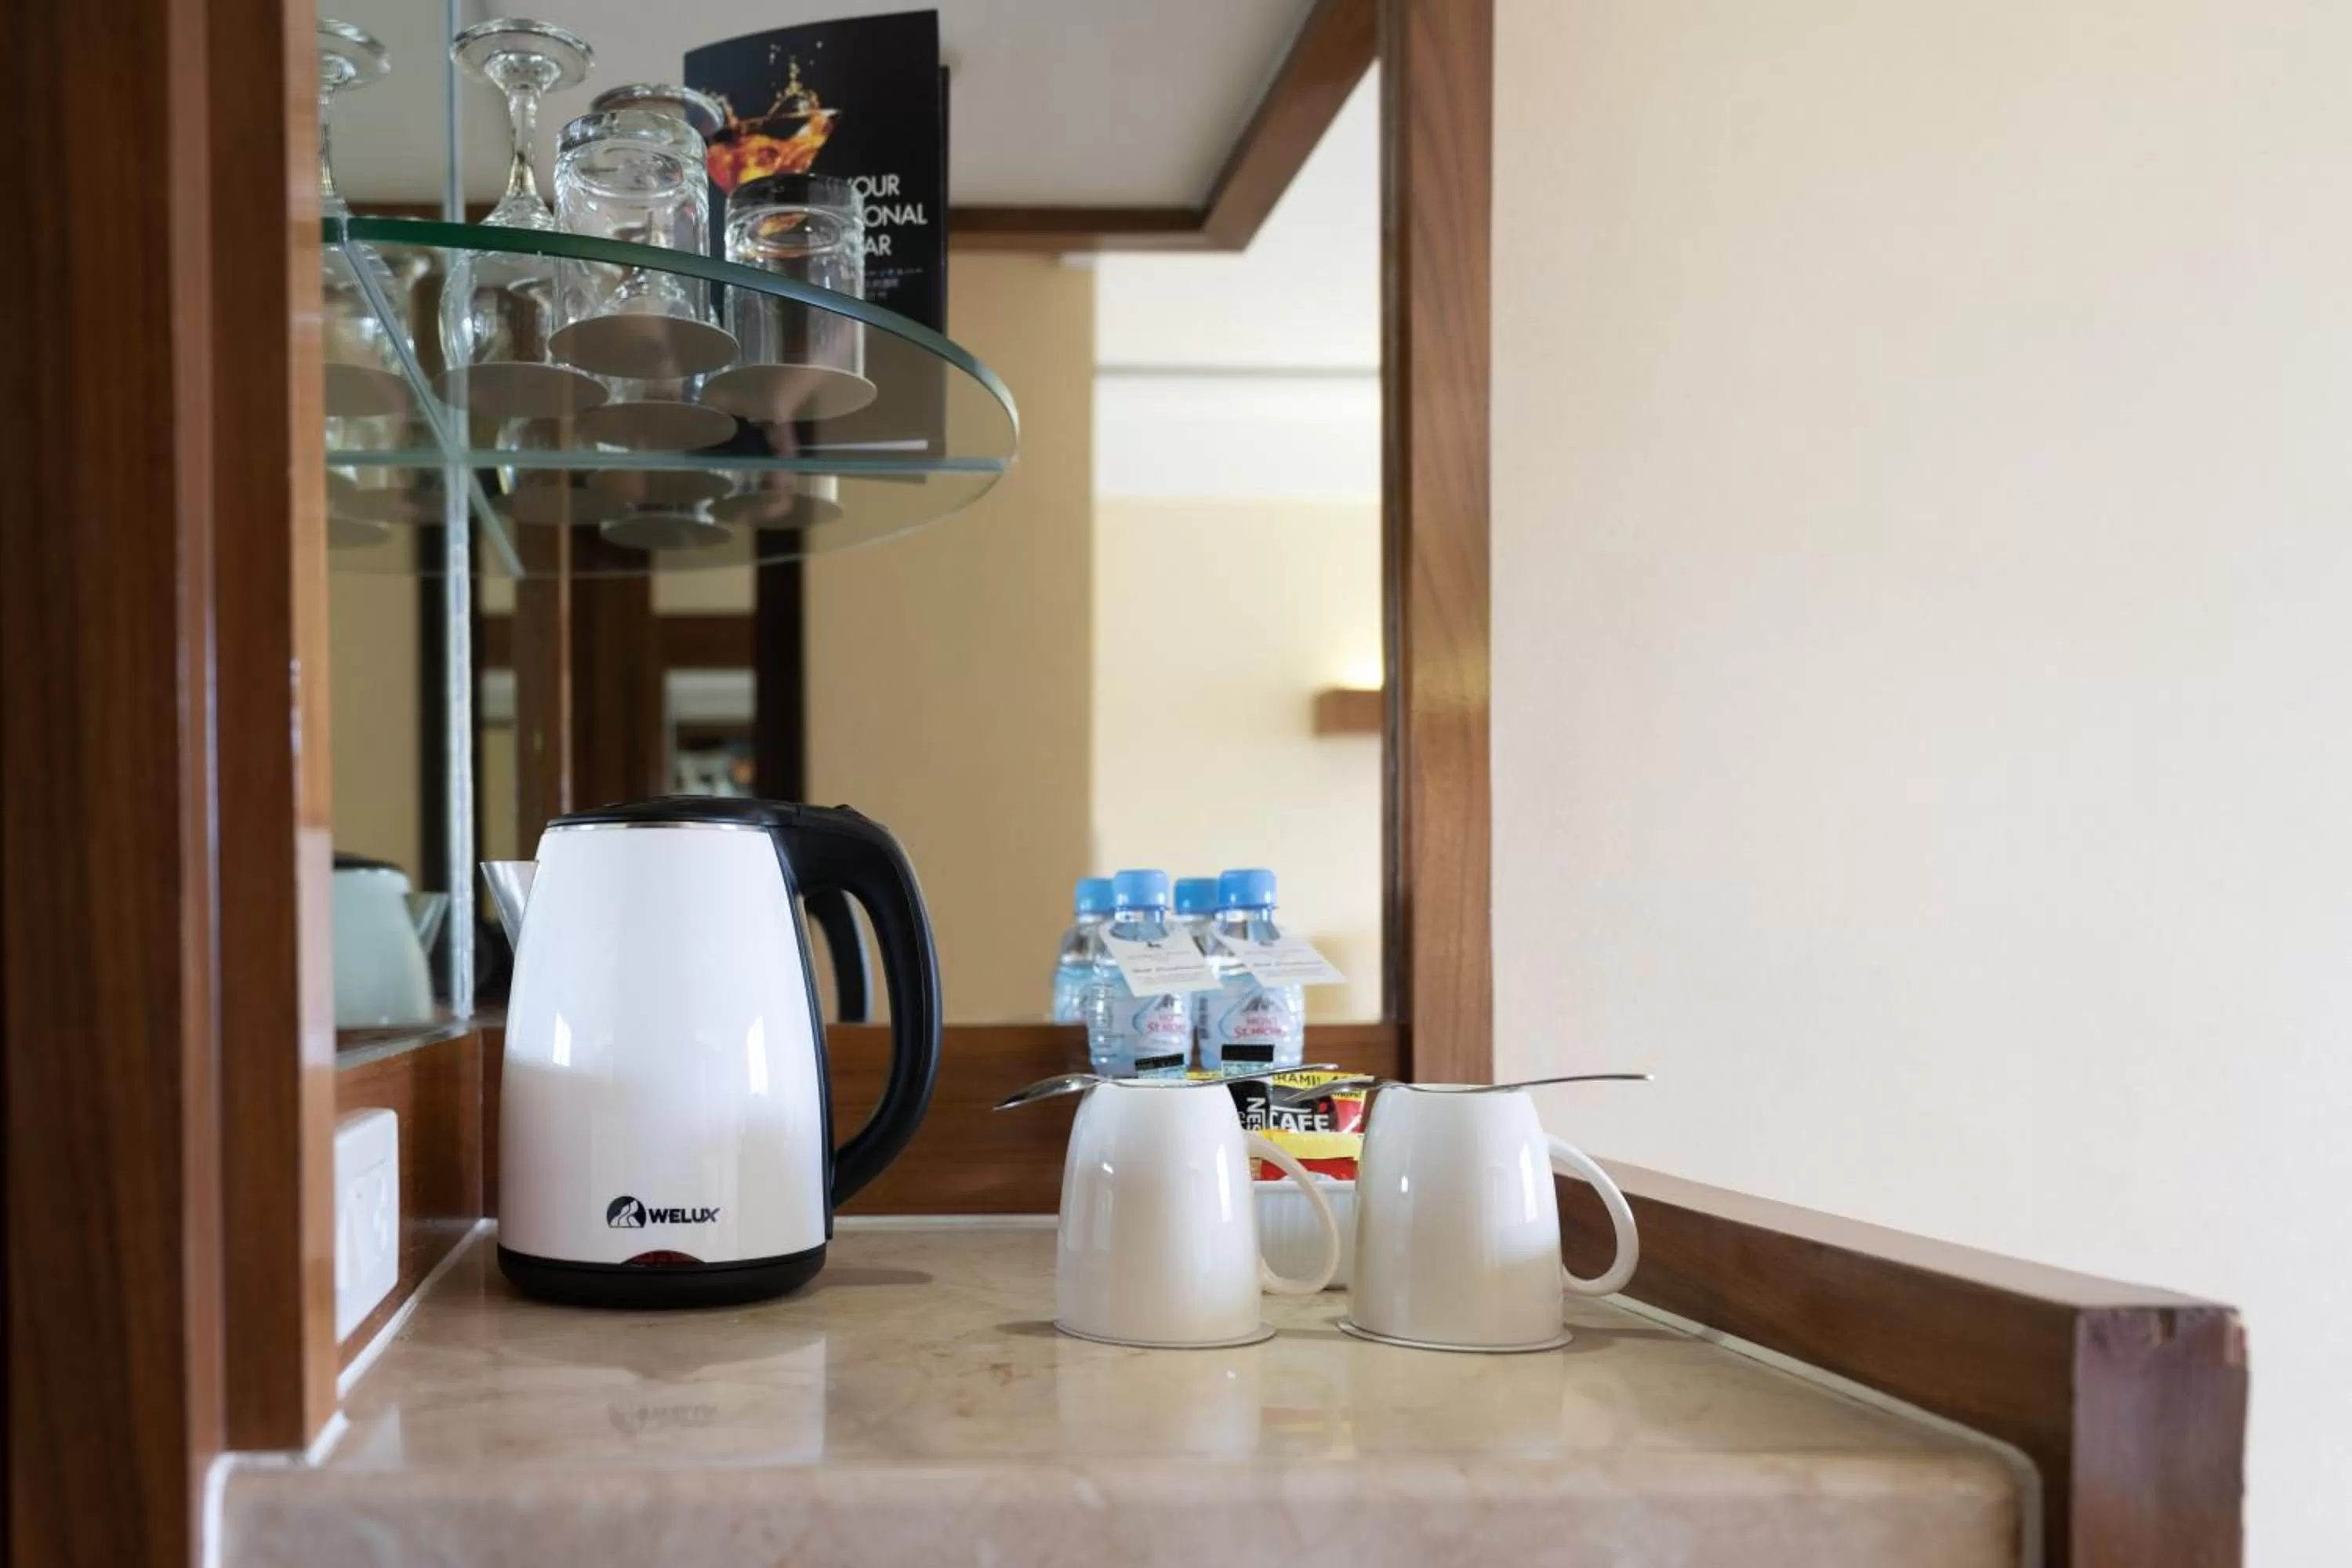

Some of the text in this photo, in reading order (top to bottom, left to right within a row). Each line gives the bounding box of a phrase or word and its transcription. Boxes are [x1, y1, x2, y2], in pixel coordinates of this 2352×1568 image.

[847, 173, 900, 197] OUR
[863, 201, 928, 227] ONAL
[863, 234, 892, 256] AR
[648, 1207, 720, 1224] WELUX
